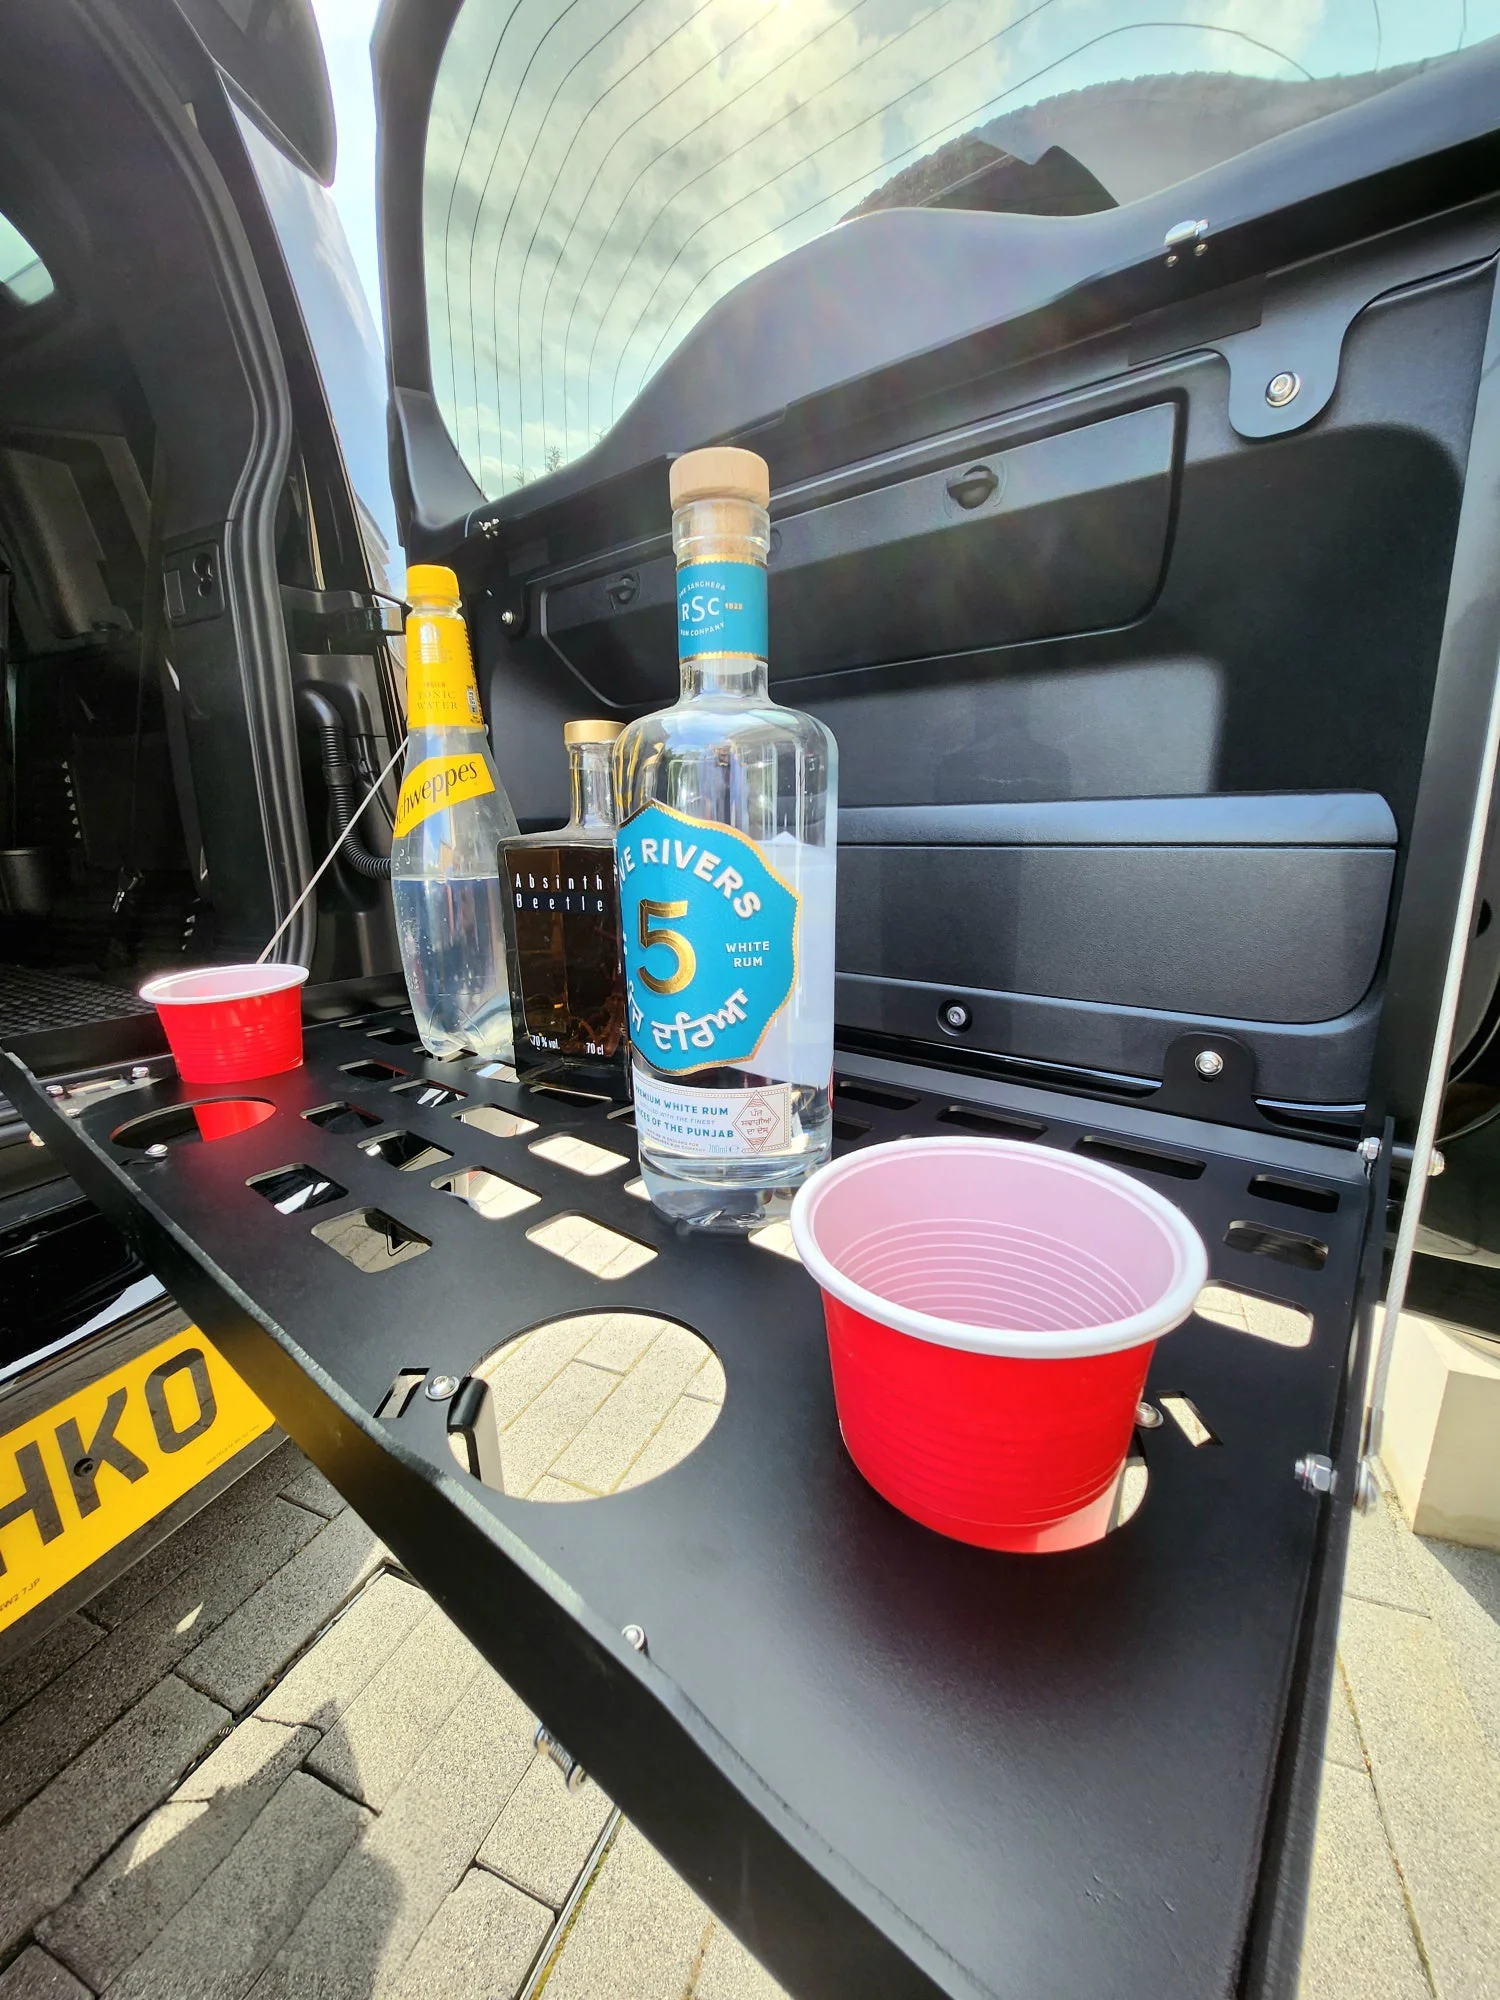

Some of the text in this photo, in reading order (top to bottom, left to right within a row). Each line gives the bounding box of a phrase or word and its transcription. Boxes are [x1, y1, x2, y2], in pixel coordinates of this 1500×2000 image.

[681, 595, 720, 623] RSC
[690, 622, 725, 637] COMPANY
[417, 690, 456, 700] TONIC
[417, 701, 458, 710] WATER
[394, 761, 478, 833] chweppes
[515, 872, 603, 891] Absinth
[641, 838, 761, 919] RIVERS
[515, 893, 604, 912] Beetle
[637, 898, 697, 996] 5
[725, 941, 770, 953] WHITE
[733, 956, 763, 968] RUM
[585, 1042, 596, 1055] 70
[664, 1100, 698, 1114] WHITE
[702, 1107, 729, 1116] RUM
[651, 1117, 664, 1128] OF
[664, 1121, 683, 1134] THE
[687, 1127, 734, 1138] PUNJAB
[0, 1347, 218, 1577] HKO
